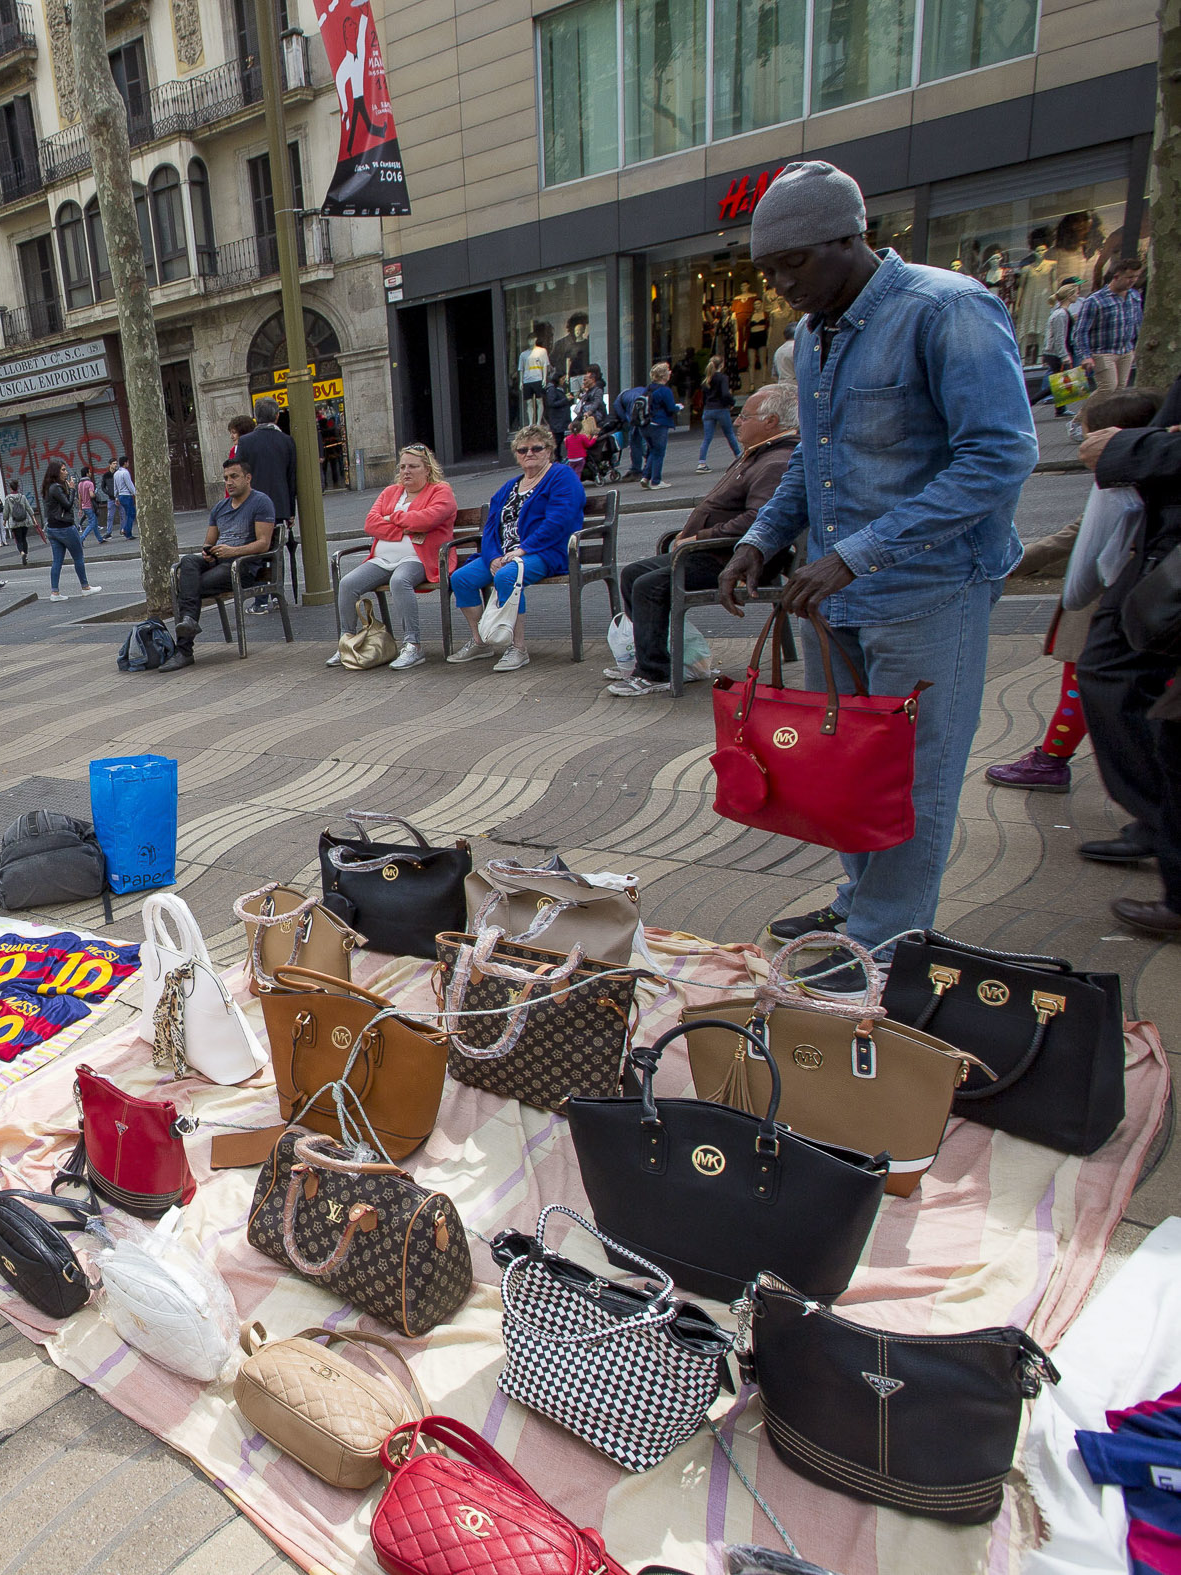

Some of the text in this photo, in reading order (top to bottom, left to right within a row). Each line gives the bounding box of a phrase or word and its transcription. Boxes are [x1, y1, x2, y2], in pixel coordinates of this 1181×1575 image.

[380, 169, 403, 182] 2016
[1, 359, 39, 376] LLOBET
[41, 355, 48, 366] Y
[38, 363, 101, 388] EMPORIUM
[85, 944, 120, 962] MESSI
[36, 951, 114, 999] 10
[2, 996, 41, 1016] MESSI
[869, 1376, 896, 1388] PRADA
